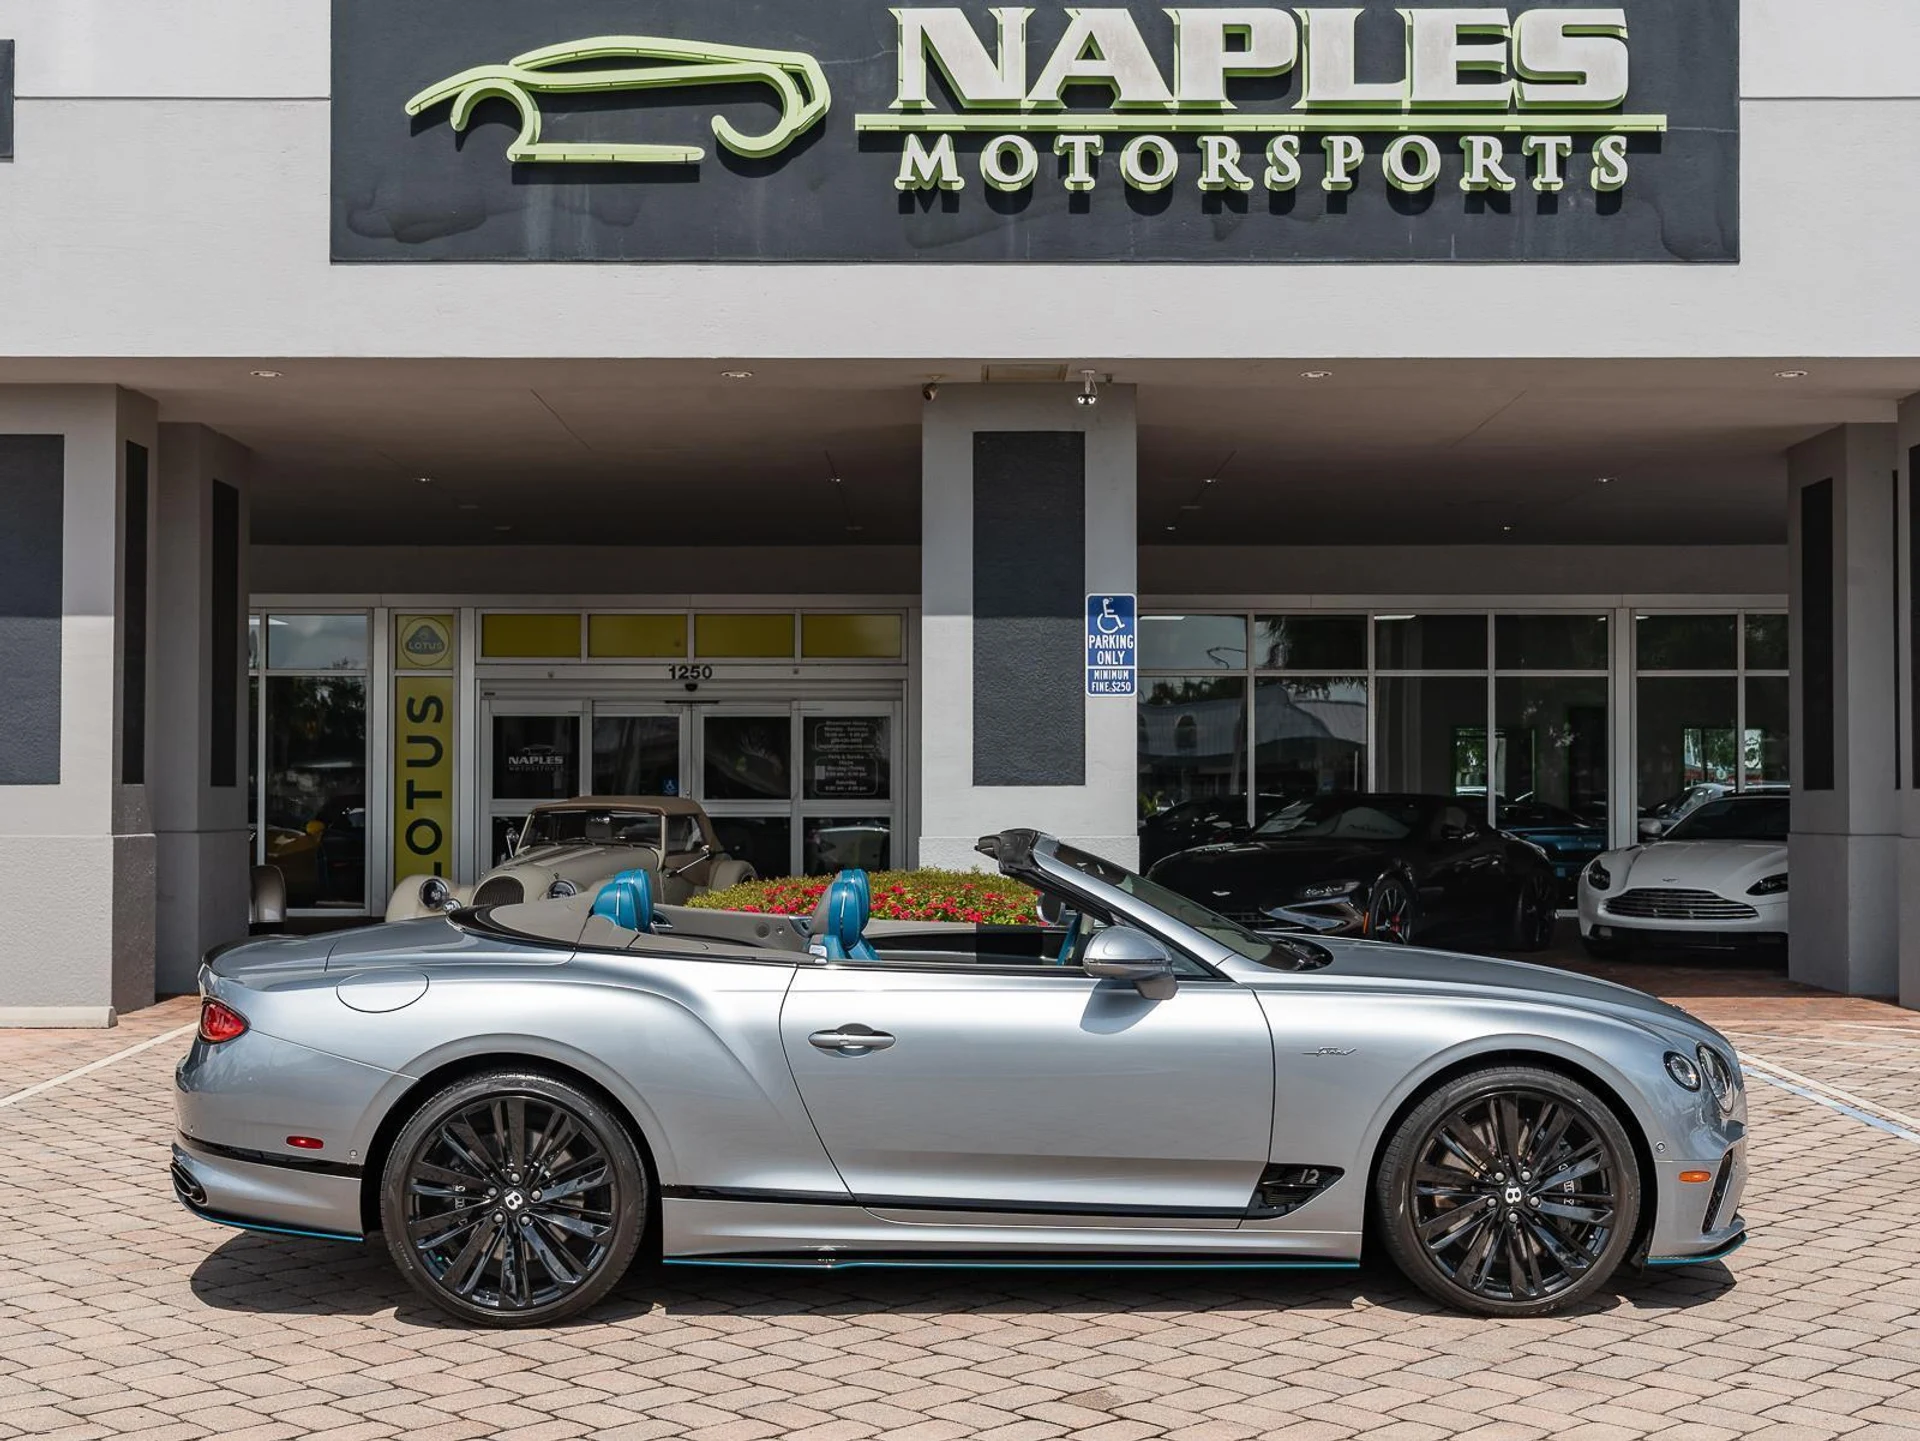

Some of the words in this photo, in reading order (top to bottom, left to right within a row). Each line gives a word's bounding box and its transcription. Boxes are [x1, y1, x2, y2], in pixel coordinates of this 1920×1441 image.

[888, 8, 1629, 109] NAPLES
[894, 134, 1629, 191] MOTORSPORTS
[1089, 635, 1134, 649] PARKING
[1097, 651, 1125, 665] ONLY
[668, 664, 713, 680] 1250
[1094, 670, 1129, 680] MINIMUM
[508, 756, 564, 765] NAPLES
[1300, 1168, 1320, 1185] 12
